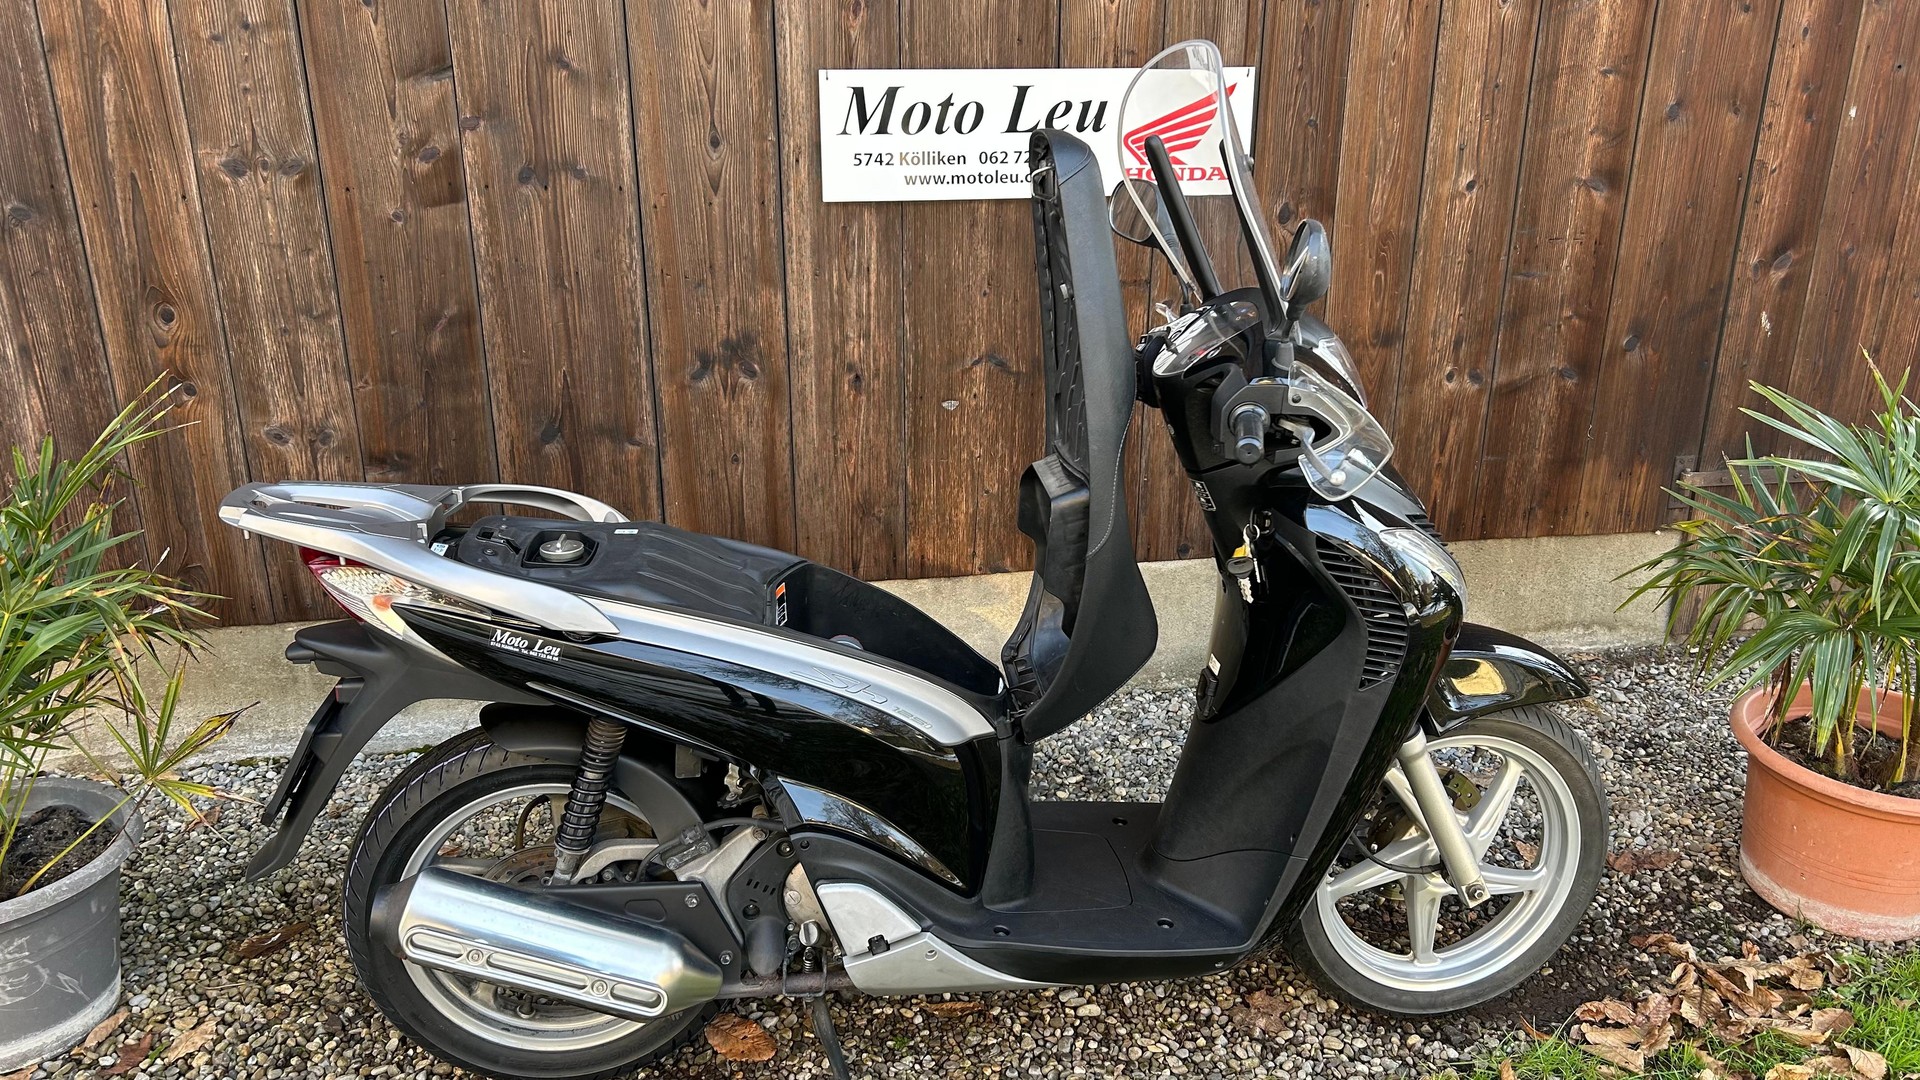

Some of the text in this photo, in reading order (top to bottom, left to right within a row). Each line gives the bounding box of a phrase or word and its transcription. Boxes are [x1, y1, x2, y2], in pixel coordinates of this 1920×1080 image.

[836, 84, 1109, 136] Moto Leu
[853, 150, 1031, 167] 5742 Kölliken 062 72
[904, 169, 1032, 186] www.motoleu.c
[491, 628, 561, 656] Moto Leu
